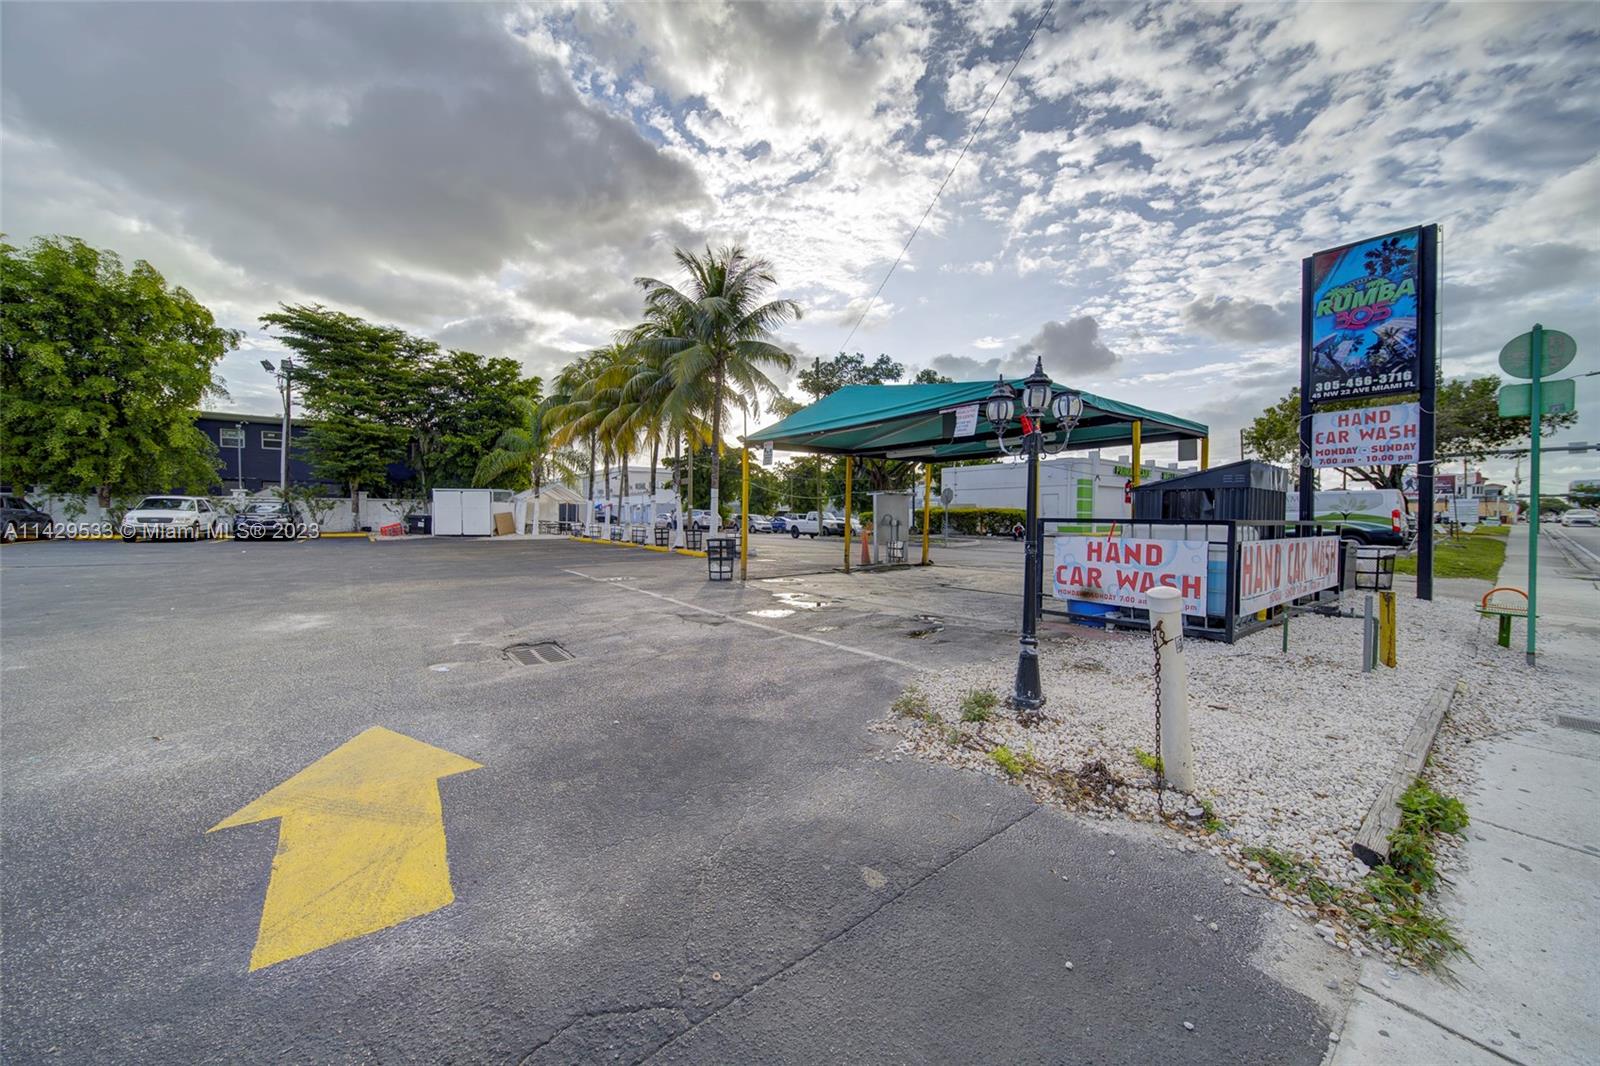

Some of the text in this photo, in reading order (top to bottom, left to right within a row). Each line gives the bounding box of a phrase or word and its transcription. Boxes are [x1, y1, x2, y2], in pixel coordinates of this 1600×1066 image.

[1316, 277, 1417, 317] RUMBA
[1335, 301, 1391, 329] 305
[1315, 370, 1412, 392] 305-456-3716
[1352, 385, 1370, 394] AVE
[1372, 382, 1402, 392] MIAMI
[1338, 409, 1391, 427] HAND
[1315, 423, 1417, 445] CAR WASH
[1315, 446, 1358, 457] MONDAY
[1371, 442, 1417, 453] SUNDAY
[1398, 454, 1413, 462] pm
[1086, 541, 1163, 567] HAND
[1242, 543, 1281, 597] HAND
[1287, 542, 1307, 584] CAR
[1311, 539, 1337, 578] WASH
[1056, 564, 1202, 599] CAR WASH
[1057, 589, 1083, 597] MONDA
